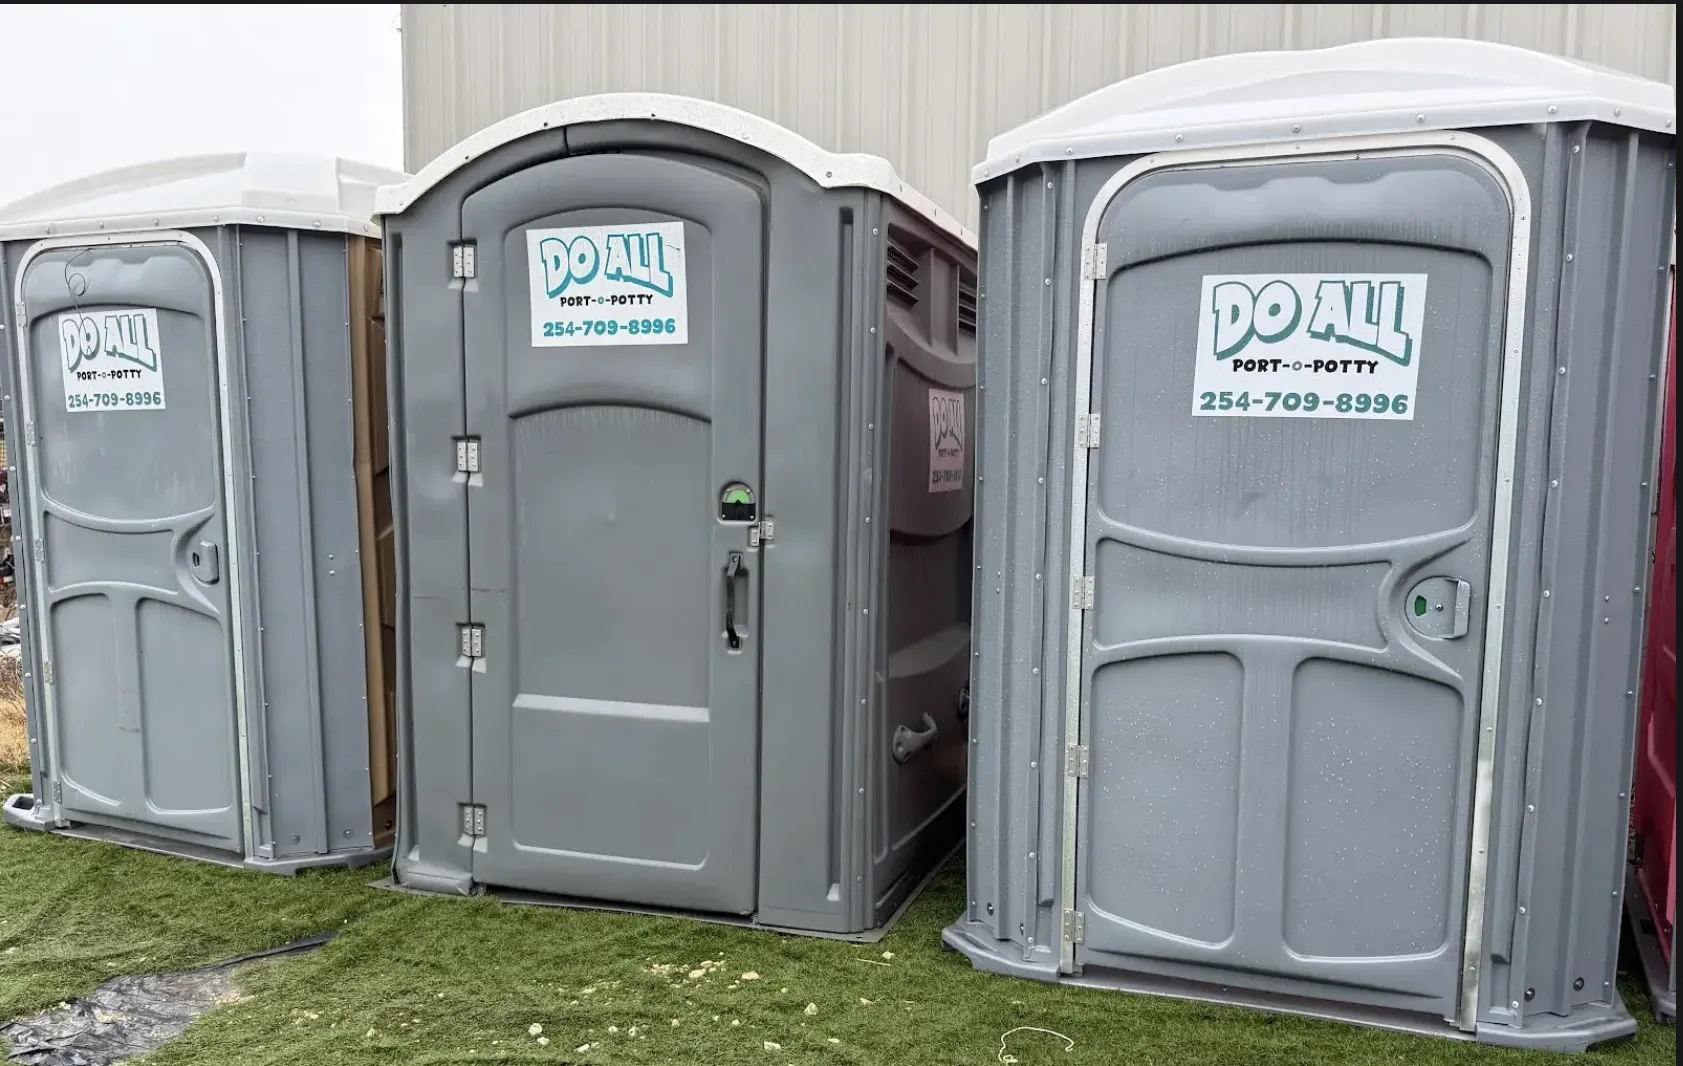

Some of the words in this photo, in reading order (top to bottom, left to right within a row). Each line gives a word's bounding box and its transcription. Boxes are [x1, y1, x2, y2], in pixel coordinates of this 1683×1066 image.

[540, 235, 600, 299] DO
[604, 232, 673, 298] ALL
[62, 316, 100, 373] DO
[104, 314, 157, 372] ALL
[543, 318, 676, 337] 254-709-8996
[1212, 280, 1302, 361] DO
[1306, 280, 1413, 367] ALL
[68, 391, 162, 408] 254-709-8996
[1199, 391, 1409, 414] 254-709-8996
